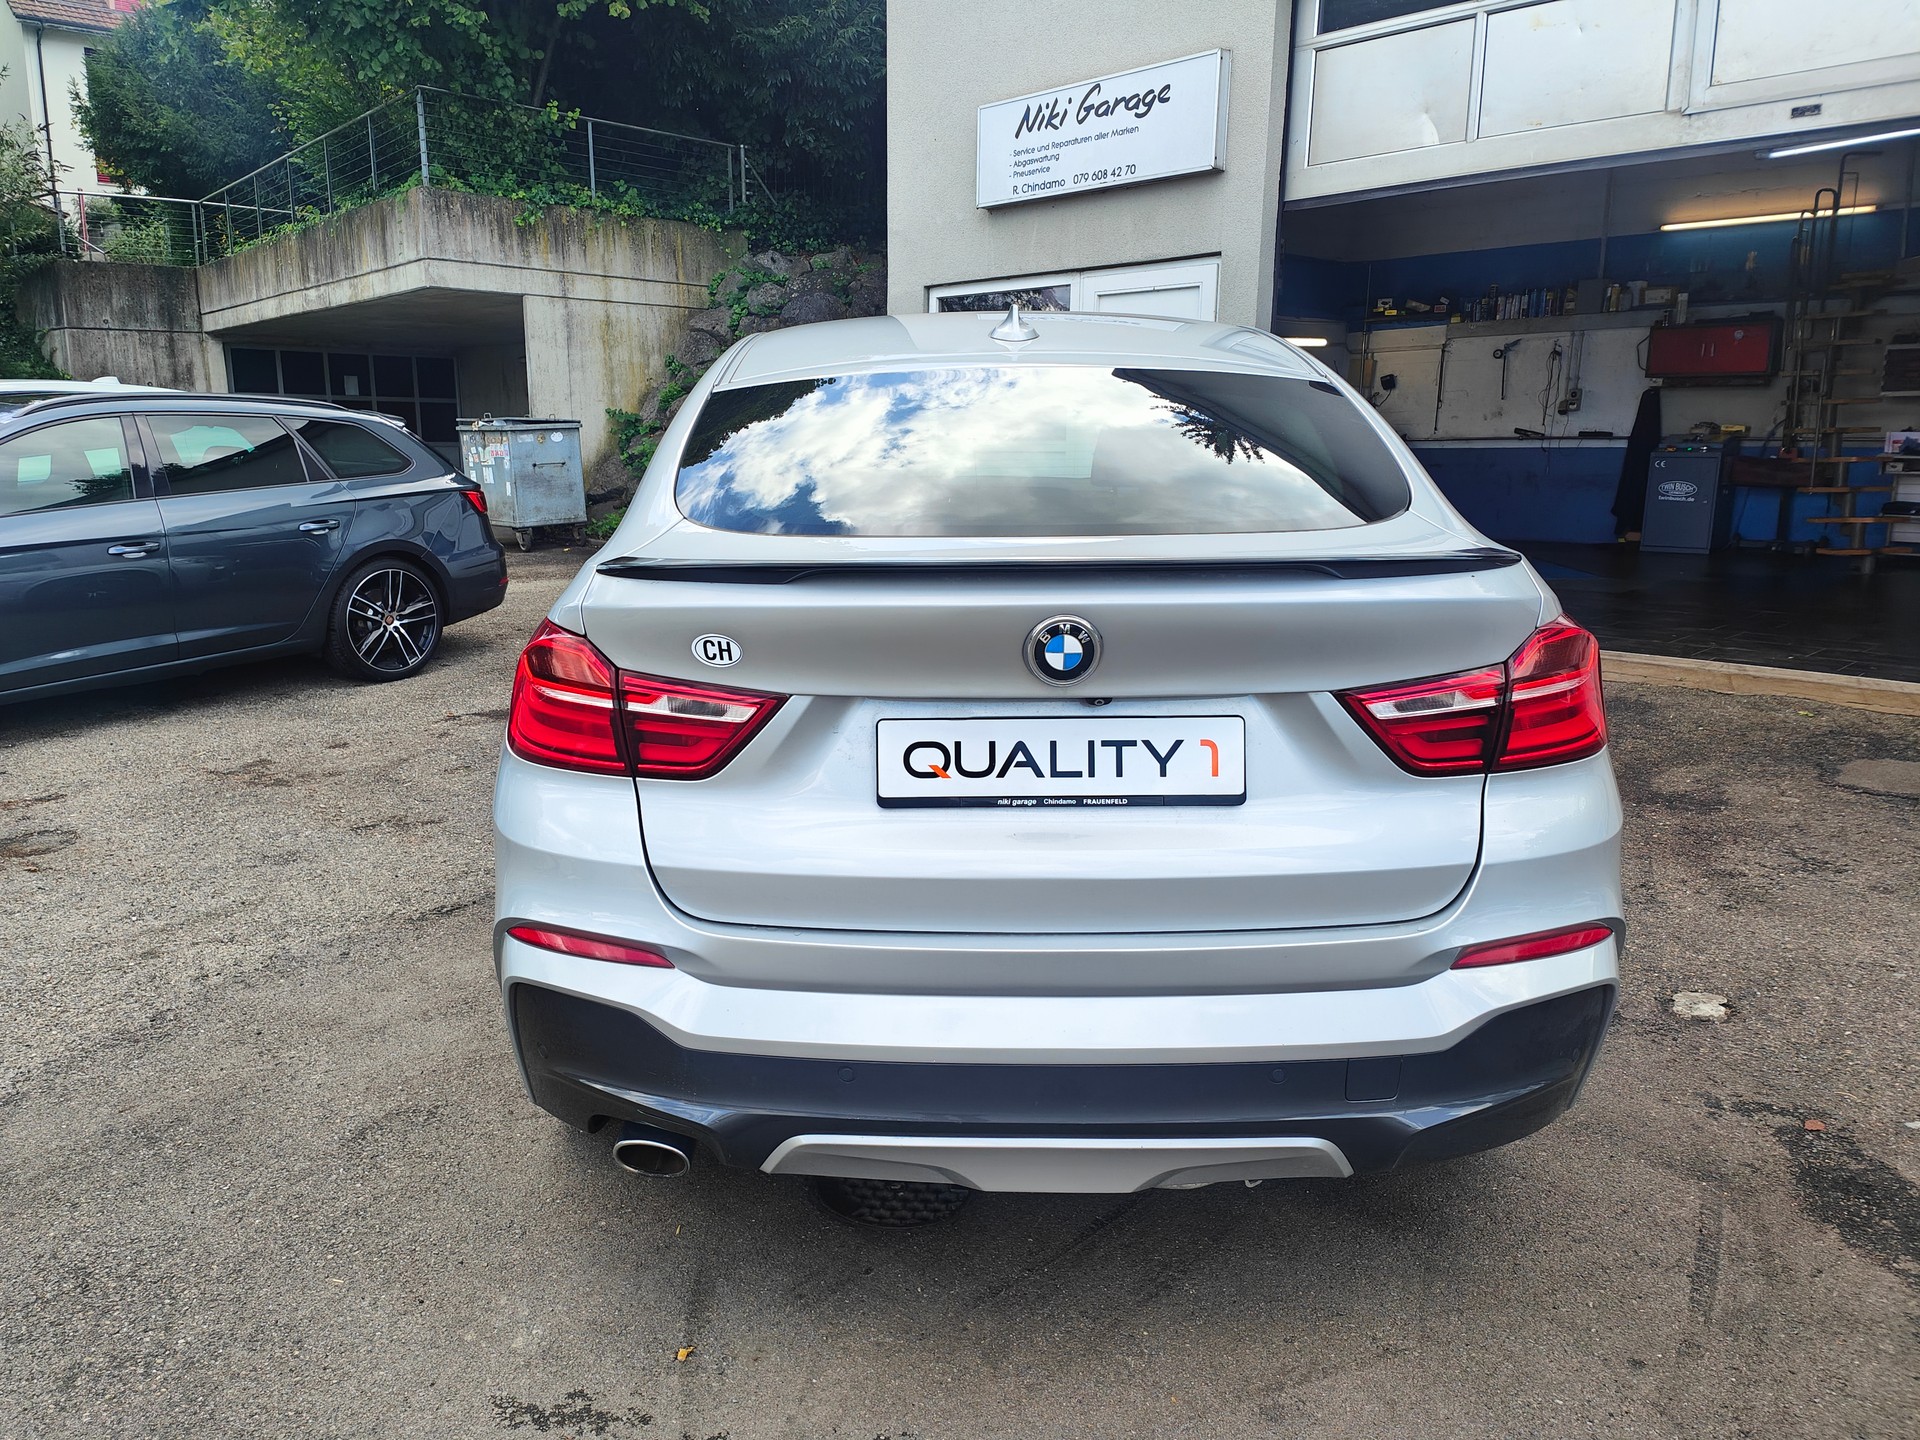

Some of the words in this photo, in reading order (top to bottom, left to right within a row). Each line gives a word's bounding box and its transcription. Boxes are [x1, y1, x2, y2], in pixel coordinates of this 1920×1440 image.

[1014, 97, 1073, 139] Niki
[1076, 83, 1171, 125] Garage
[1013, 147, 1036, 158] Service
[1036, 143, 1050, 153] und
[1050, 135, 1093, 150] Reparaturen
[1093, 131, 1110, 141] aller
[1110, 126, 1140, 138] Marken
[1013, 152, 1060, 168] Abgaswartung
[1013, 165, 1051, 179] Pneuservice
[1021, 178, 1066, 194] Chindamo
[1072, 172, 1089, 185] 079
[1091, 169, 1108, 181] 608
[1110, 166, 1122, 178] 42
[1124, 164, 1136, 176] 70
[1675, 483, 1694, 492] BUSCH
[1039, 623, 1091, 644] BMW
[703, 639, 733, 661] CH
[902, 739, 1185, 779] QUALITY
[1199, 739, 1219, 777] 1
[1012, 798, 1037, 807] garage
